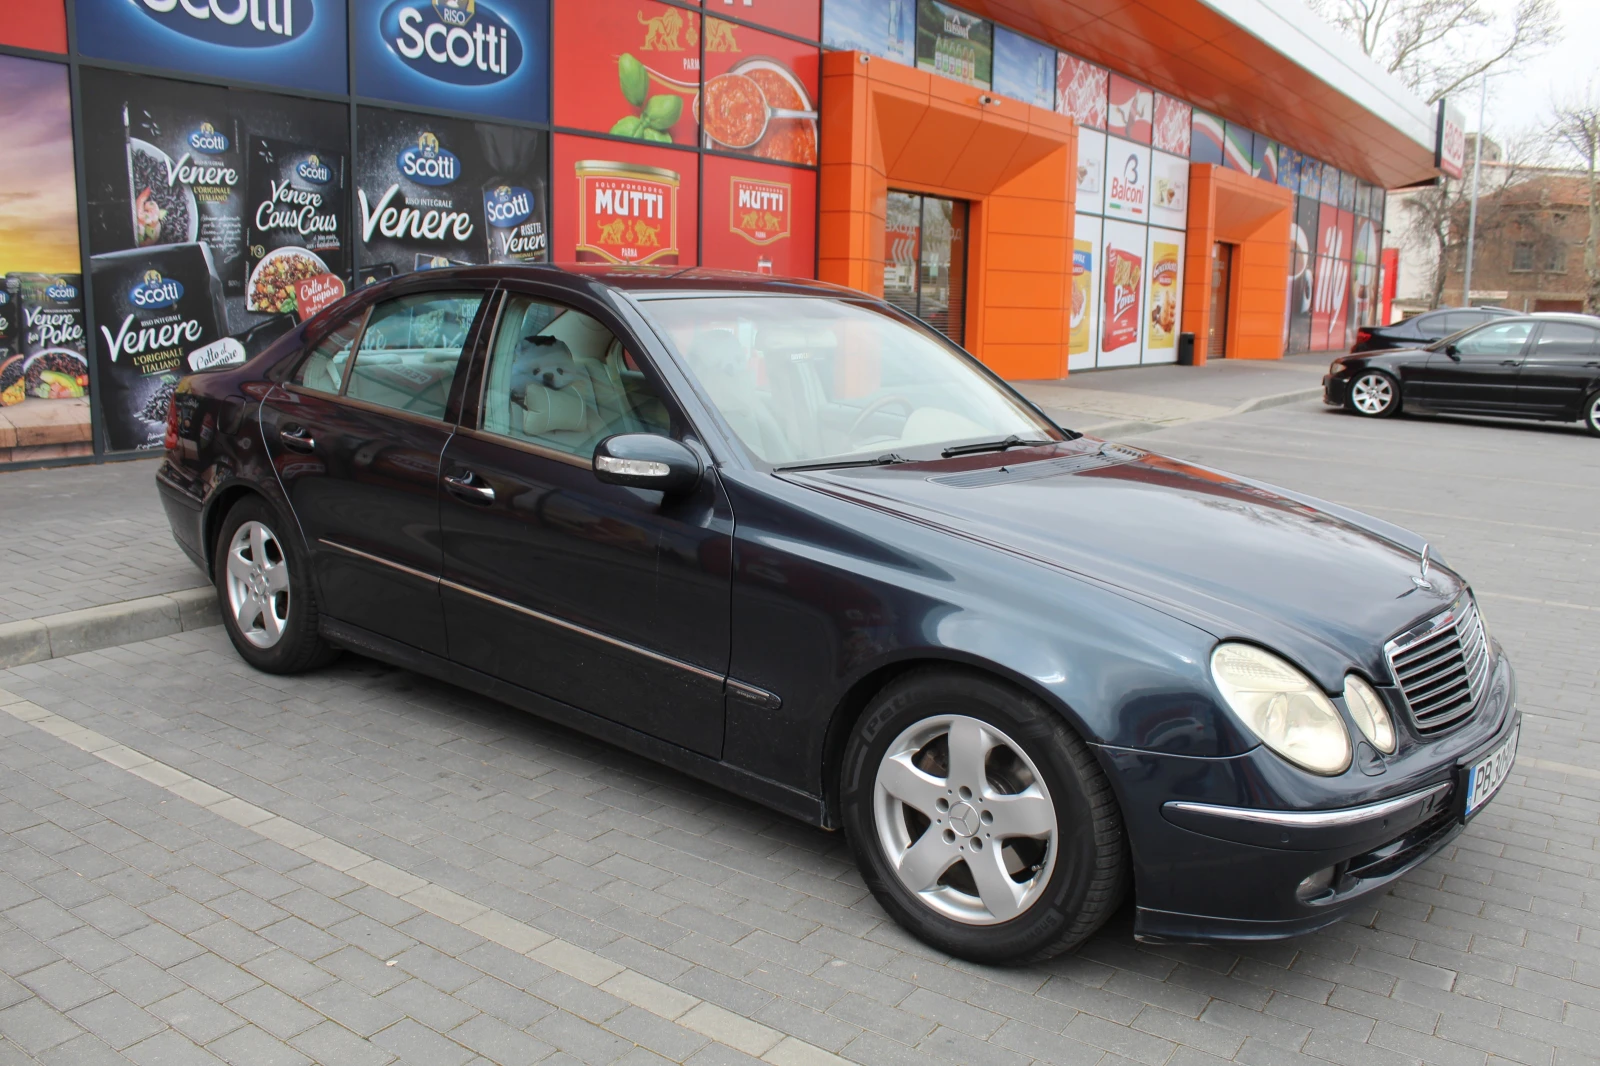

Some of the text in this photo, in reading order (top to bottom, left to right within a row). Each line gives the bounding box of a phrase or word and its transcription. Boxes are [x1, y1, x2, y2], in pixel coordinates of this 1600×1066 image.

[444, 8, 465, 23] RISO
[396, 7, 507, 75] Scotti
[192, 134, 224, 150] Scotti
[164, 153, 238, 187] Venere
[299, 164, 328, 181] Scotti
[403, 152, 454, 179] Scotti
[193, 186, 231, 195] L'ORIGINALE
[199, 193, 227, 201] ITALIANO
[271, 179, 323, 207] Venere
[739, 189, 783, 212] MUTTI
[1110, 176, 1144, 204] Balconi
[357, 183, 474, 243] Venere
[405, 197, 452, 208] RISO INTEGRALE
[487, 193, 529, 222] Scotti
[595, 188, 663, 219] MUTTI
[520, 222, 542, 235] RISETTE
[300, 279, 321, 301] Cotto
[1315, 226, 1348, 334] illy
[48, 287, 75, 298] Scotti
[134, 282, 179, 305] Scotti
[312, 285, 339, 303] vapore
[24, 306, 75, 327] Venere
[37, 323, 83, 347] Poke
[101, 313, 202, 363] Venere
[132, 347, 184, 366] L'ORIGINALE
[141, 359, 180, 374] ITALIANO
